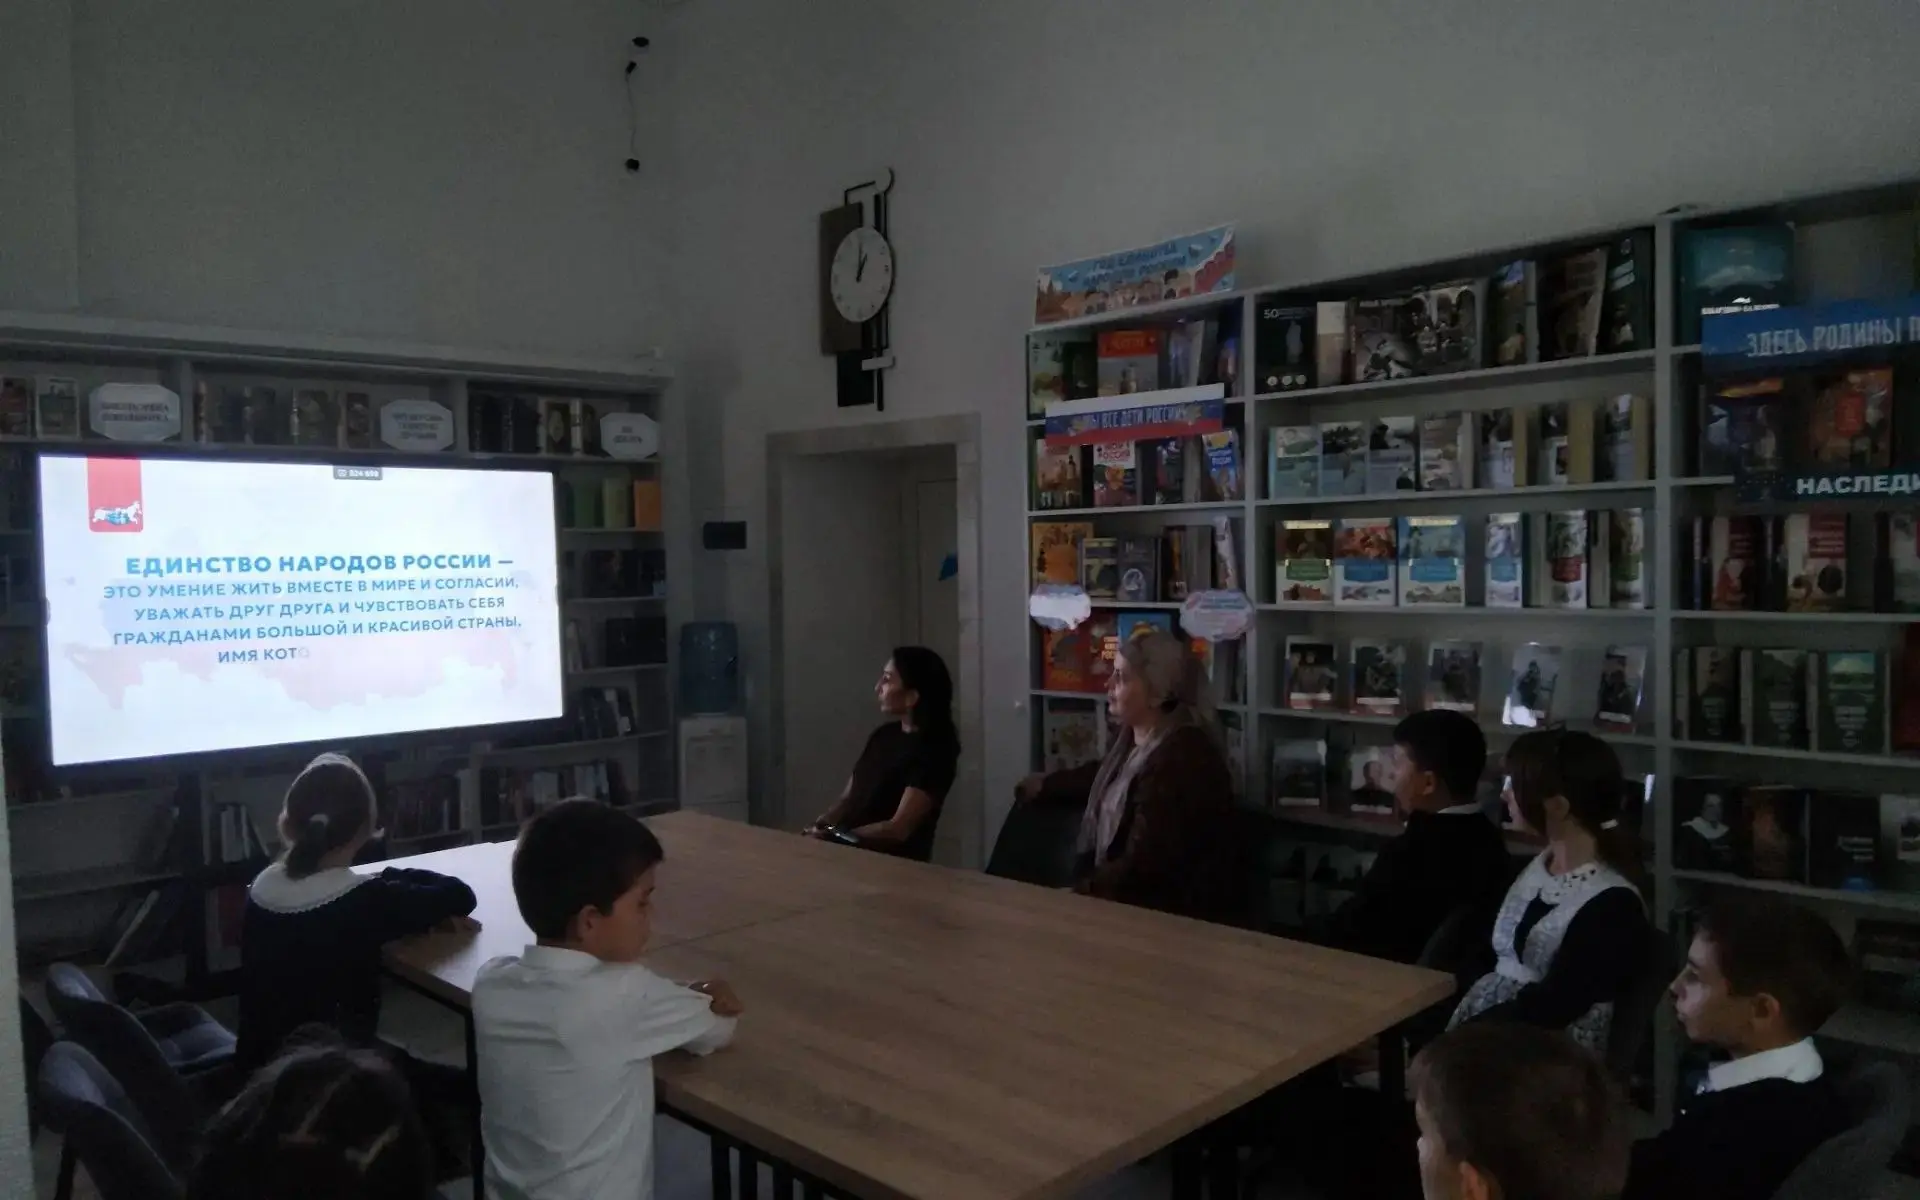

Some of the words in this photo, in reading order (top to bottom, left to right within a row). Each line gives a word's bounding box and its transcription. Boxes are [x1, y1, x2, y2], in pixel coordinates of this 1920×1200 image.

[1746, 328, 1807, 358] ЗДЕСЬ
[1813, 316, 1901, 352] РОДИНЫ
[126, 556, 272, 578] ЕДИНСТВО
[279, 555, 397, 574] НАРОДОВ
[403, 554, 491, 570] РОССИИ
[103, 585, 142, 599] ЭТО
[147, 584, 226, 598] УМЕНИЕ
[231, 582, 282, 596] ЖИТЬ
[287, 580, 353, 594] ВМЕСТЕ
[358, 580, 368, 592] В
[372, 579, 415, 591] МИРЕ
[421, 578, 430, 590] И
[435, 577, 519, 590] СОГЛАСИИ,
[134, 606, 224, 621] УВАЖАТЬ
[229, 604, 275, 620] ДРУГ
[279, 602, 335, 618] ДРУГА
[339, 602, 349, 613] И
[354, 599, 465, 613] ЧУВСТВОВАТЬ
[468, 597, 505, 609] СЕБЯ
[113, 628, 251, 645] ГРАЖДАНАМИ
[256, 620, 347, 639] БОЛЬШОЙ
[352, 623, 363, 634] И
[368, 616, 453, 633] КРАСИВОЙ
[218, 650, 258, 664] ИМЯ
